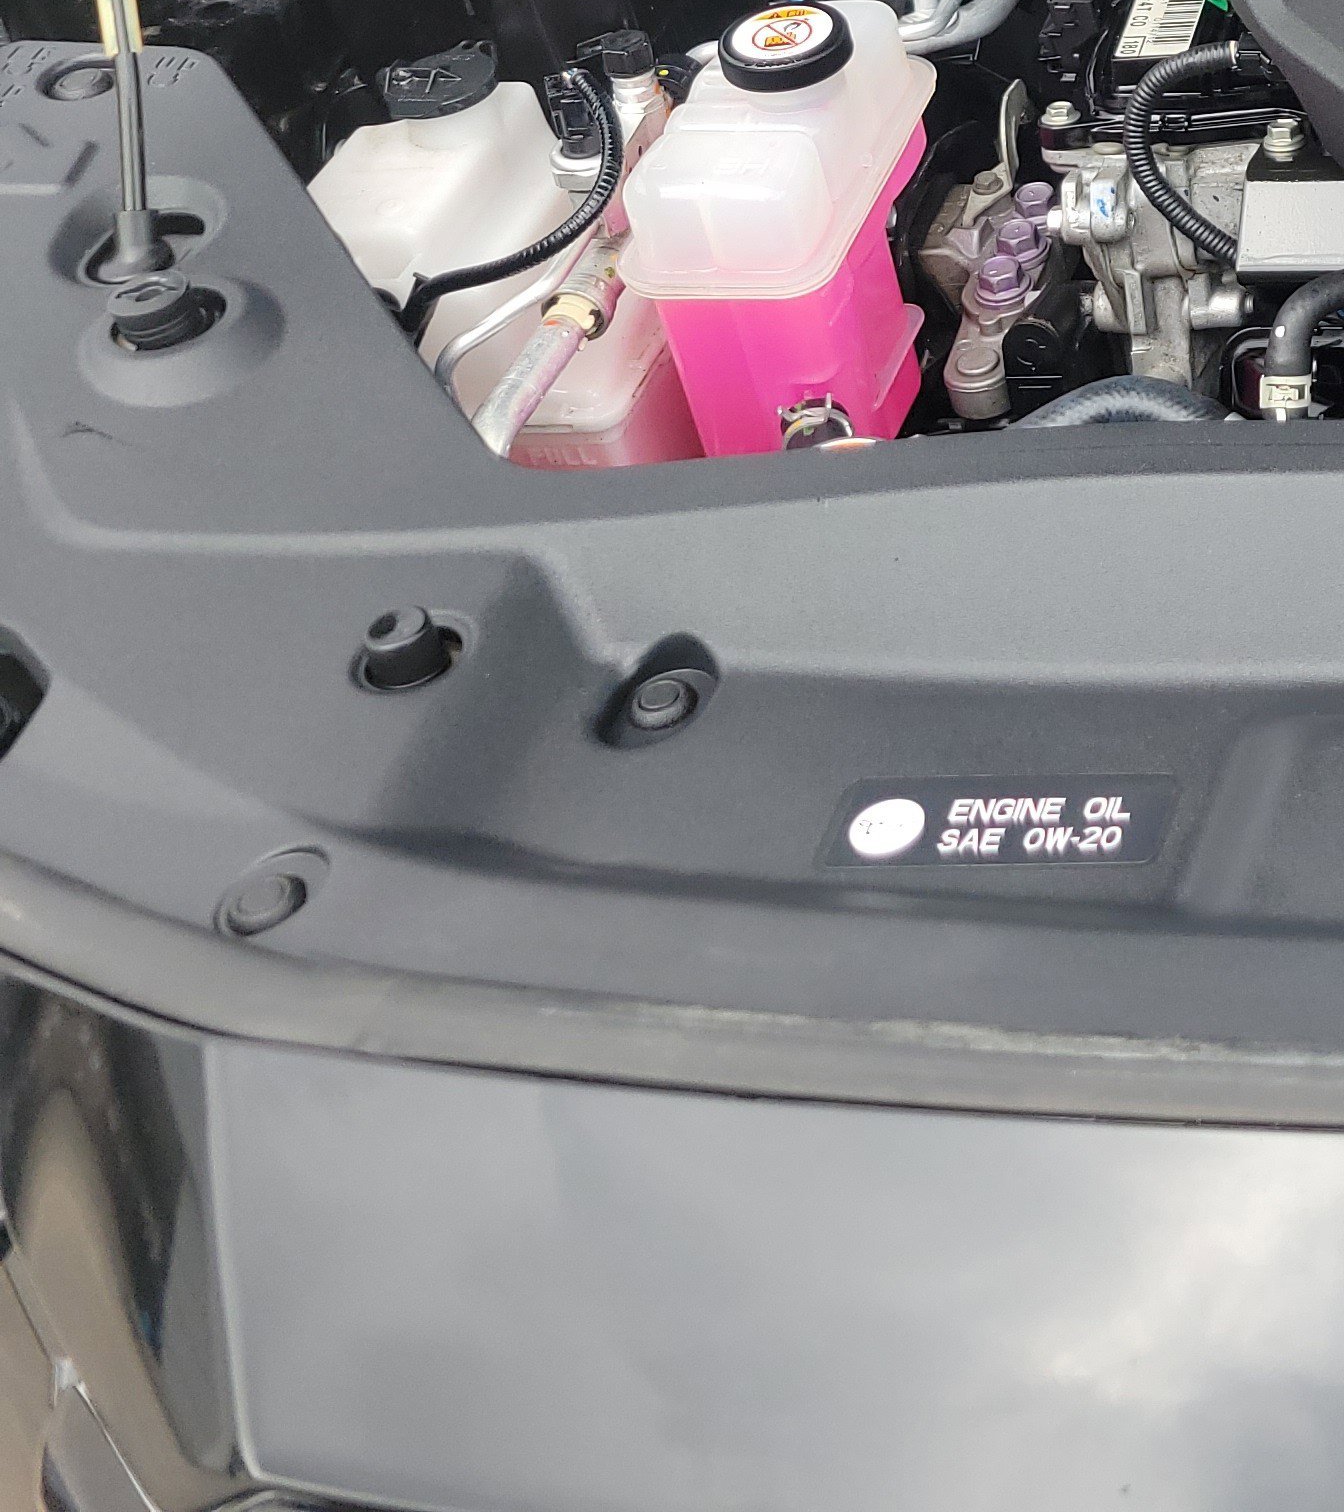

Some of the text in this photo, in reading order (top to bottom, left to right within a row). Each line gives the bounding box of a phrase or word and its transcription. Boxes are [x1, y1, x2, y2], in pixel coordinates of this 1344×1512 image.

[1120, 40, 1139, 54] 180
[947, 796, 1131, 823] ENGINE OIL
[936, 825, 1122, 853] SAE 0W-20
